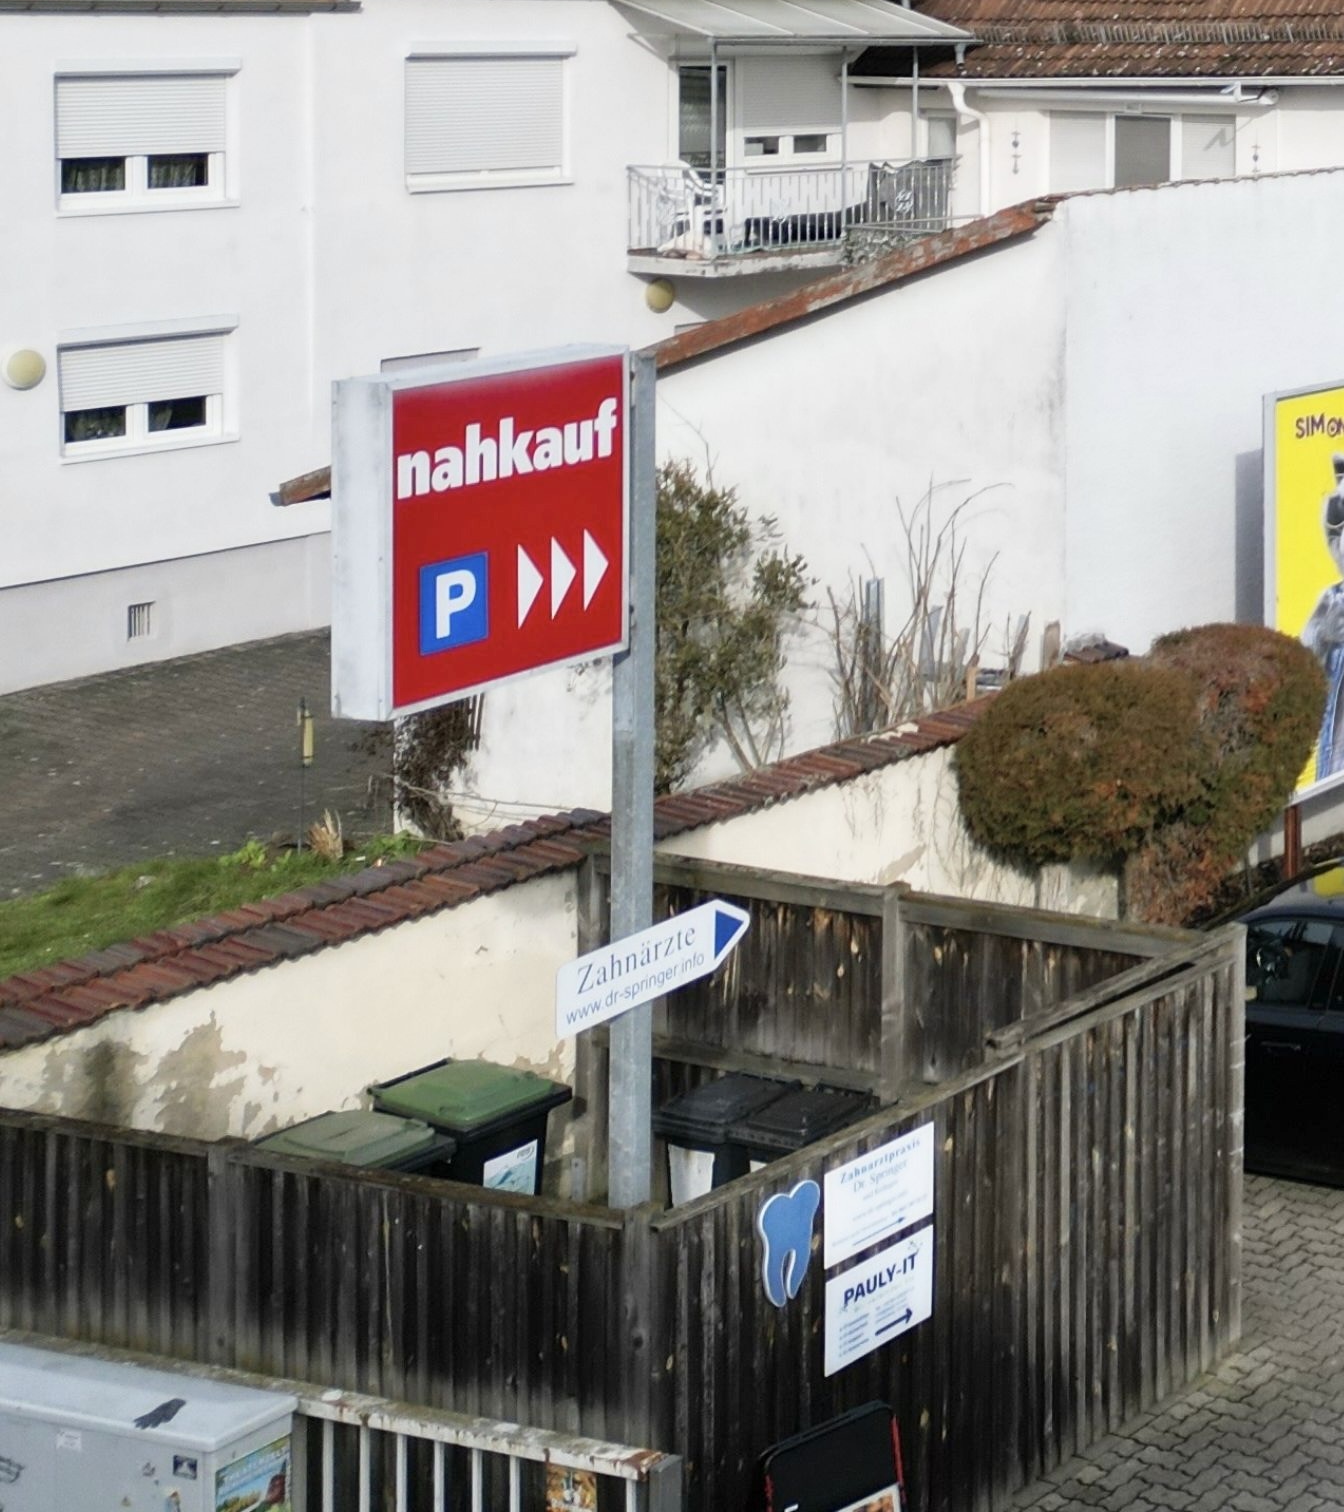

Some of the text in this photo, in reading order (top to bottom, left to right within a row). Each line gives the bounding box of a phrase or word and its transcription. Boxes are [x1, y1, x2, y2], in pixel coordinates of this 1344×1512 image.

[397, 398, 618, 499] nahkauf
[436, 569, 477, 639] P
[577, 926, 696, 995] Zahnärzte
[843, 1250, 919, 1308] PAULY-IT
